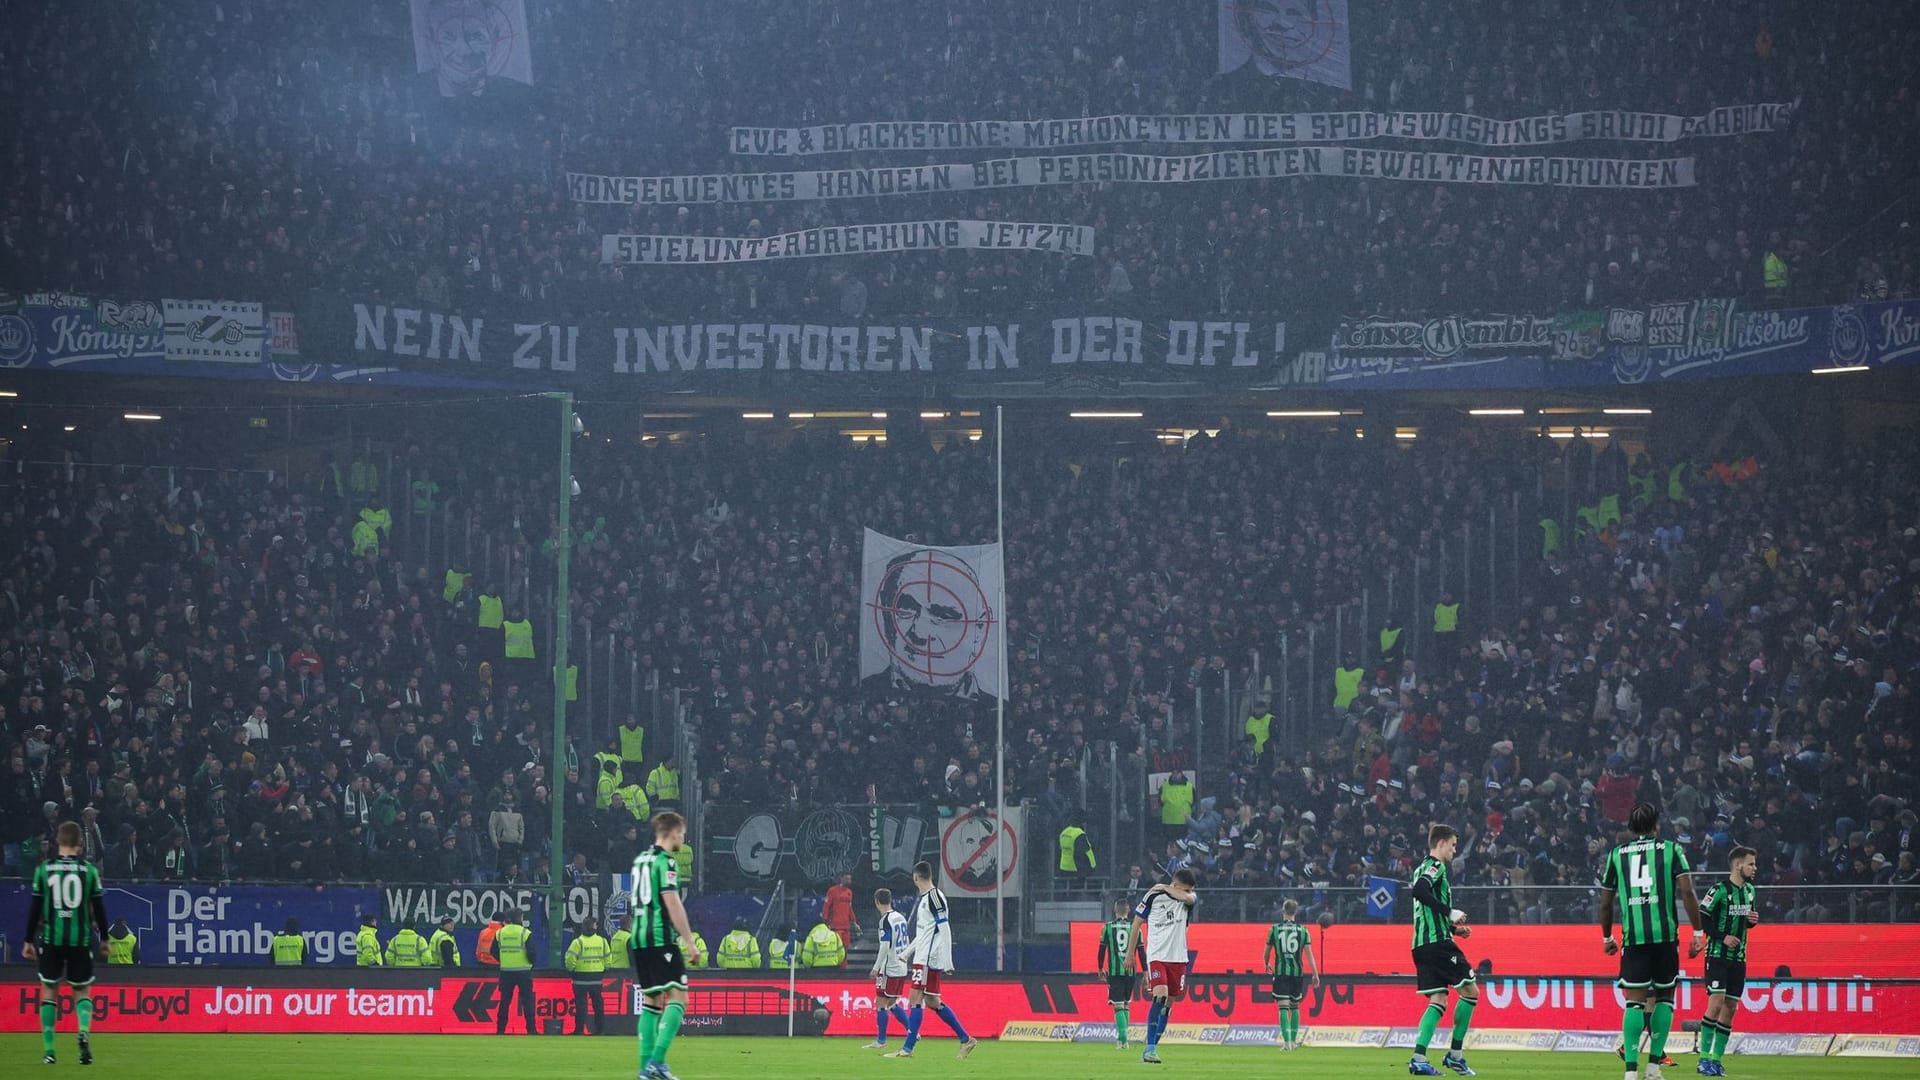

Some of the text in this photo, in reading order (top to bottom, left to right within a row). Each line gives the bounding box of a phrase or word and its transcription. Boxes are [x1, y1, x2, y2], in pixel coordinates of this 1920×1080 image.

[735, 128, 788, 154] CVC
[797, 128, 815, 153] &
[823, 121, 1012, 151] BLACKSTONE:
[1023, 114, 1231, 146] MARIONETTEN
[1244, 114, 1296, 140] DES
[1312, 113, 1568, 144] SPORTSWASHINGS
[1582, 113, 1667, 139] SAUDI
[569, 148, 1679, 202] KONSEQUENTES HANDELN BEI PERSONIFIZIERTEN GEWALTANDROHUNGEN
[617, 221, 1084, 262] SPIELUNTERBRECHUNG JETZT!
[353, 302, 483, 363] NEIN
[512, 323, 578, 372] ZU
[613, 324, 933, 374] INVESTOREN
[966, 322, 1019, 369] IN
[1051, 316, 1142, 364] DER
[1166, 319, 1257, 367] DFL
[1630, 854, 1653, 893] 4
[47, 874, 83, 909] 10
[168, 889, 232, 922] Der
[386, 888, 532, 927] WALSRODE
[895, 922, 909, 949] 28
[1116, 929, 1129, 952] 9
[1278, 931, 1300, 954] 16
[912, 969, 924, 985] 23
[20, 986, 434, 1022] Hpg-Lloyd Join our team!
[1005, 1025, 1049, 1038] ADMIRAL
[1200, 1028, 1224, 1041] BET
[1227, 1027, 1276, 1042] ADMIRAL
[1307, 1031, 1356, 1042] ADMIRAL
[1474, 1033, 1523, 1045] ADMIRAL
[1555, 1033, 1612, 1049] ADMIRAL
[1738, 1036, 1796, 1051] ADMIRAL
[1799, 1038, 1828, 1051] BET
